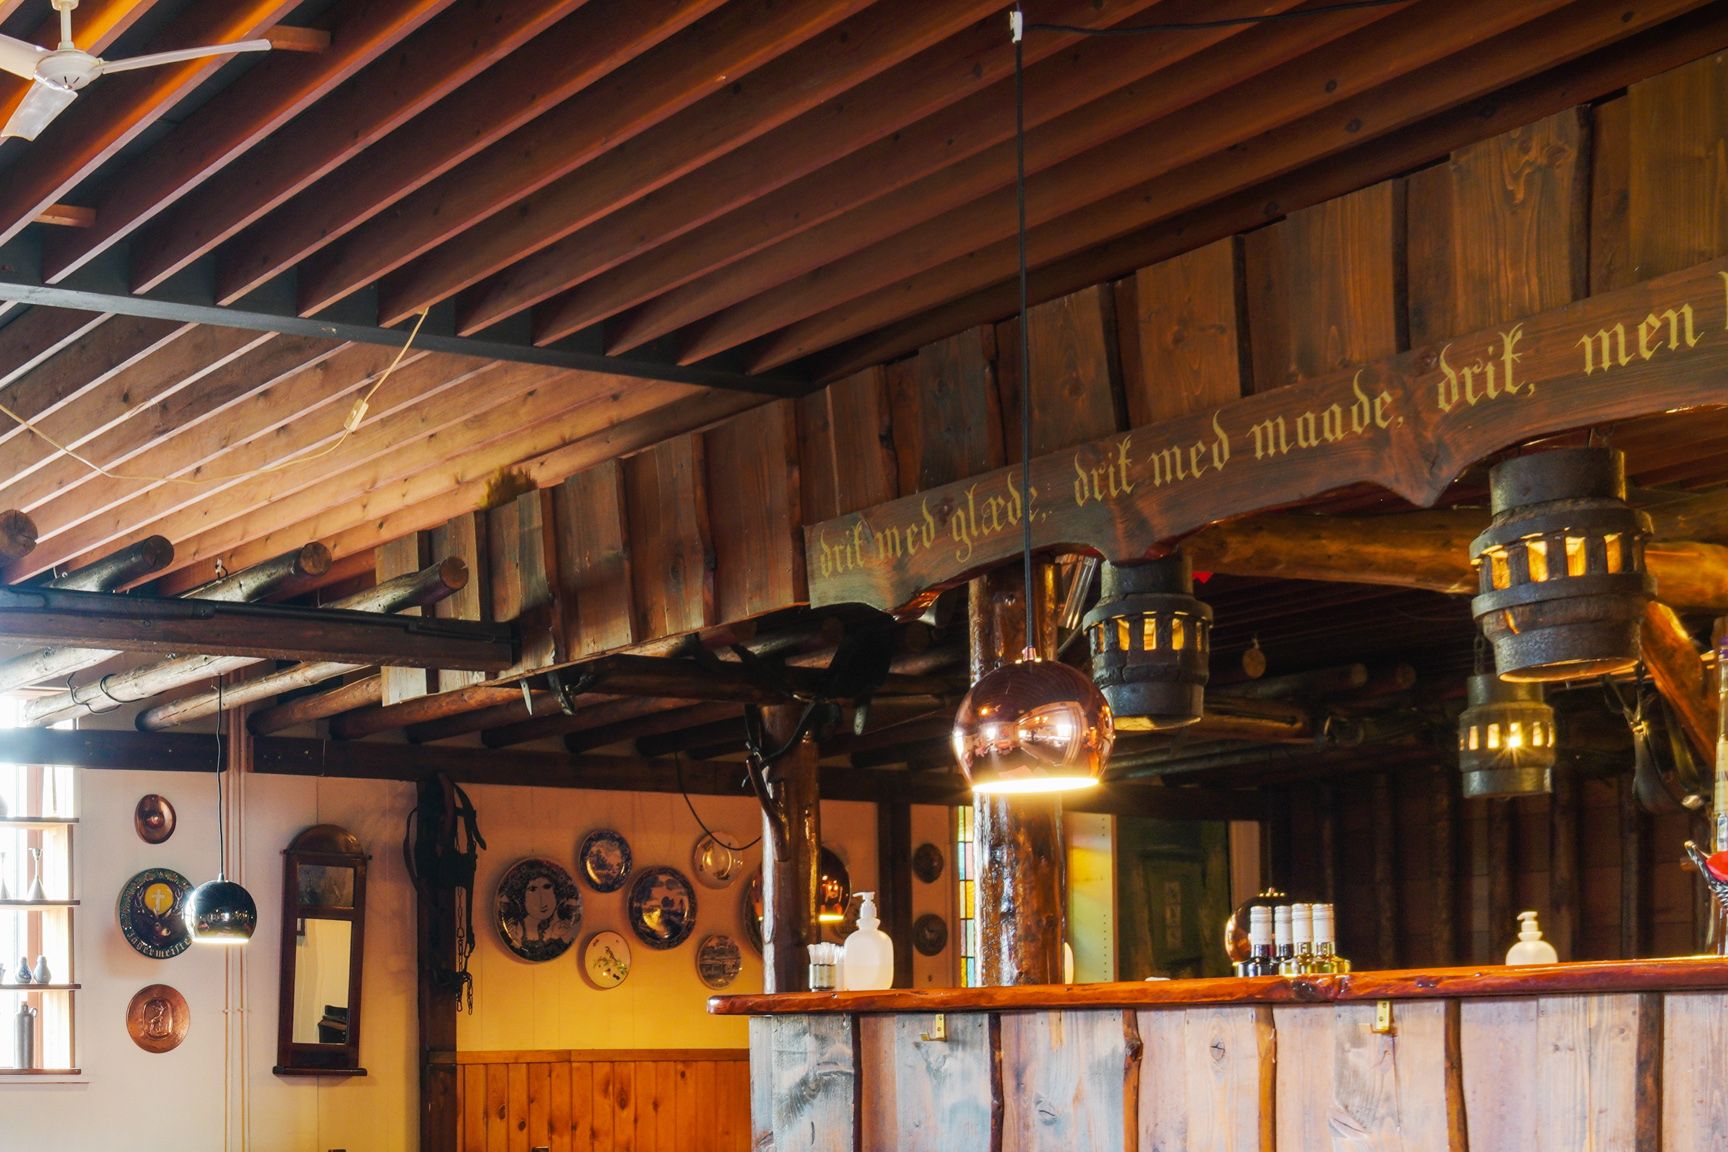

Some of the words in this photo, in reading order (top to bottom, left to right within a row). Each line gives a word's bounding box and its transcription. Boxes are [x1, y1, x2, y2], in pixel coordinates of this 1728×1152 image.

[819, 519, 865, 578] drik
[874, 496, 935, 560] med
[1073, 434, 1136, 507] drik
[1147, 409, 1231, 488] med
[1246, 368, 1404, 461] maade,
[1437, 322, 1536, 413] drik,
[1574, 303, 1705, 376] men
[127, 929, 193, 958] Jägermeiste
